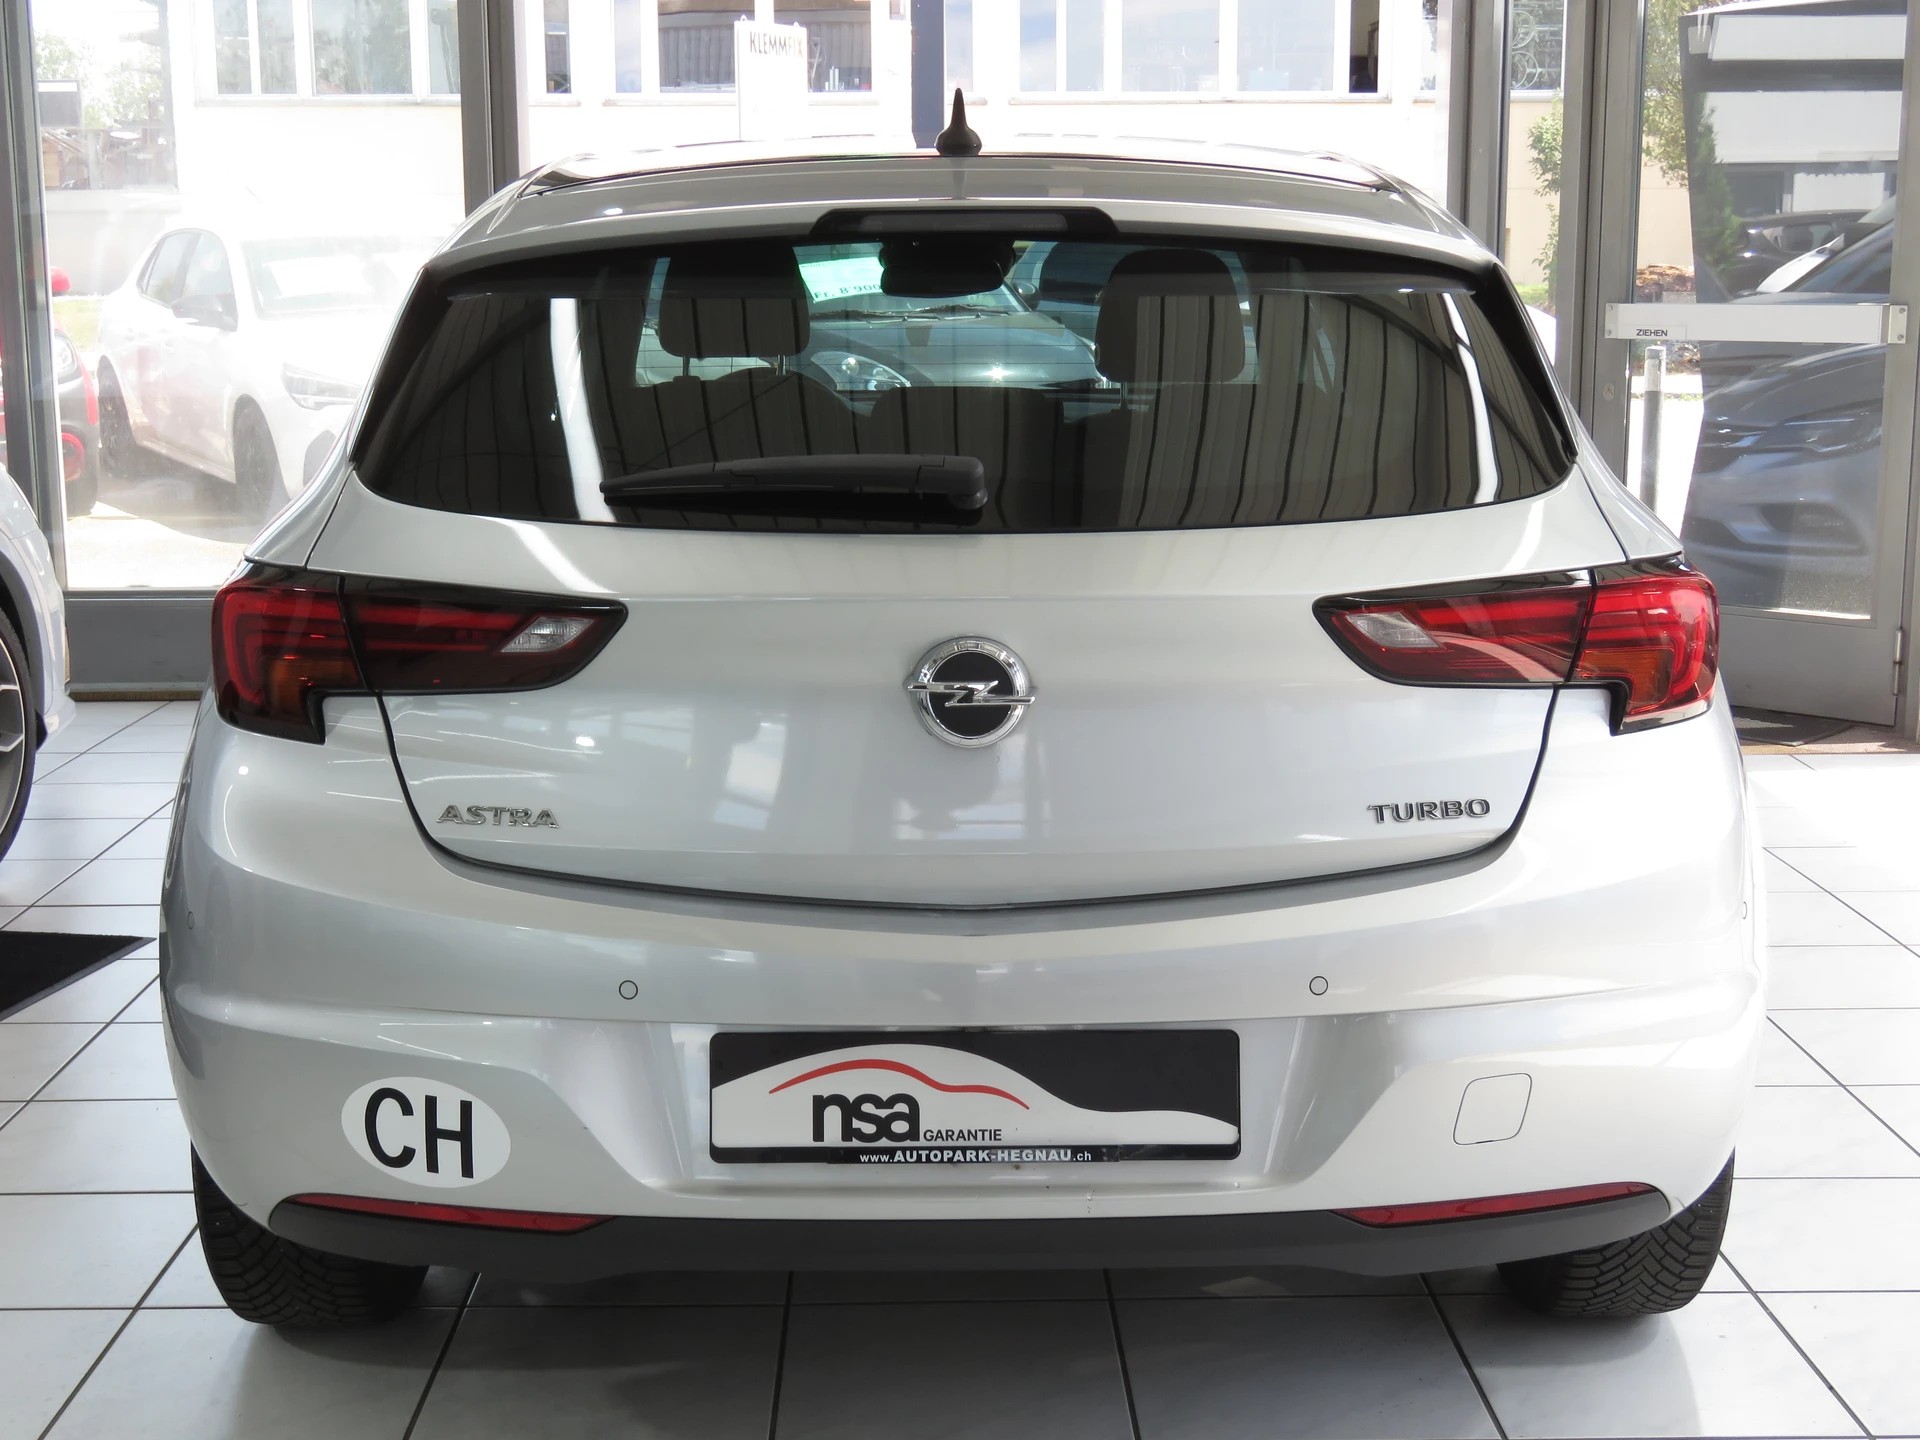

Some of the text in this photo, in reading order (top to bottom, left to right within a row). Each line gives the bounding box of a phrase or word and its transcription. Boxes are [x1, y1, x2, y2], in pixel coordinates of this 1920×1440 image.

[749, 31, 803, 58] KLEMMFIX
[1636, 328, 1668, 337] ZIEHEN
[436, 804, 559, 829] ASTRA
[1367, 798, 1490, 823] TURBO
[812, 1093, 1002, 1143] nsa GARANTIE
[364, 1087, 474, 1179] CH
[860, 1149, 1092, 1163] www.AUTOPARK-HEGNAU.ch
